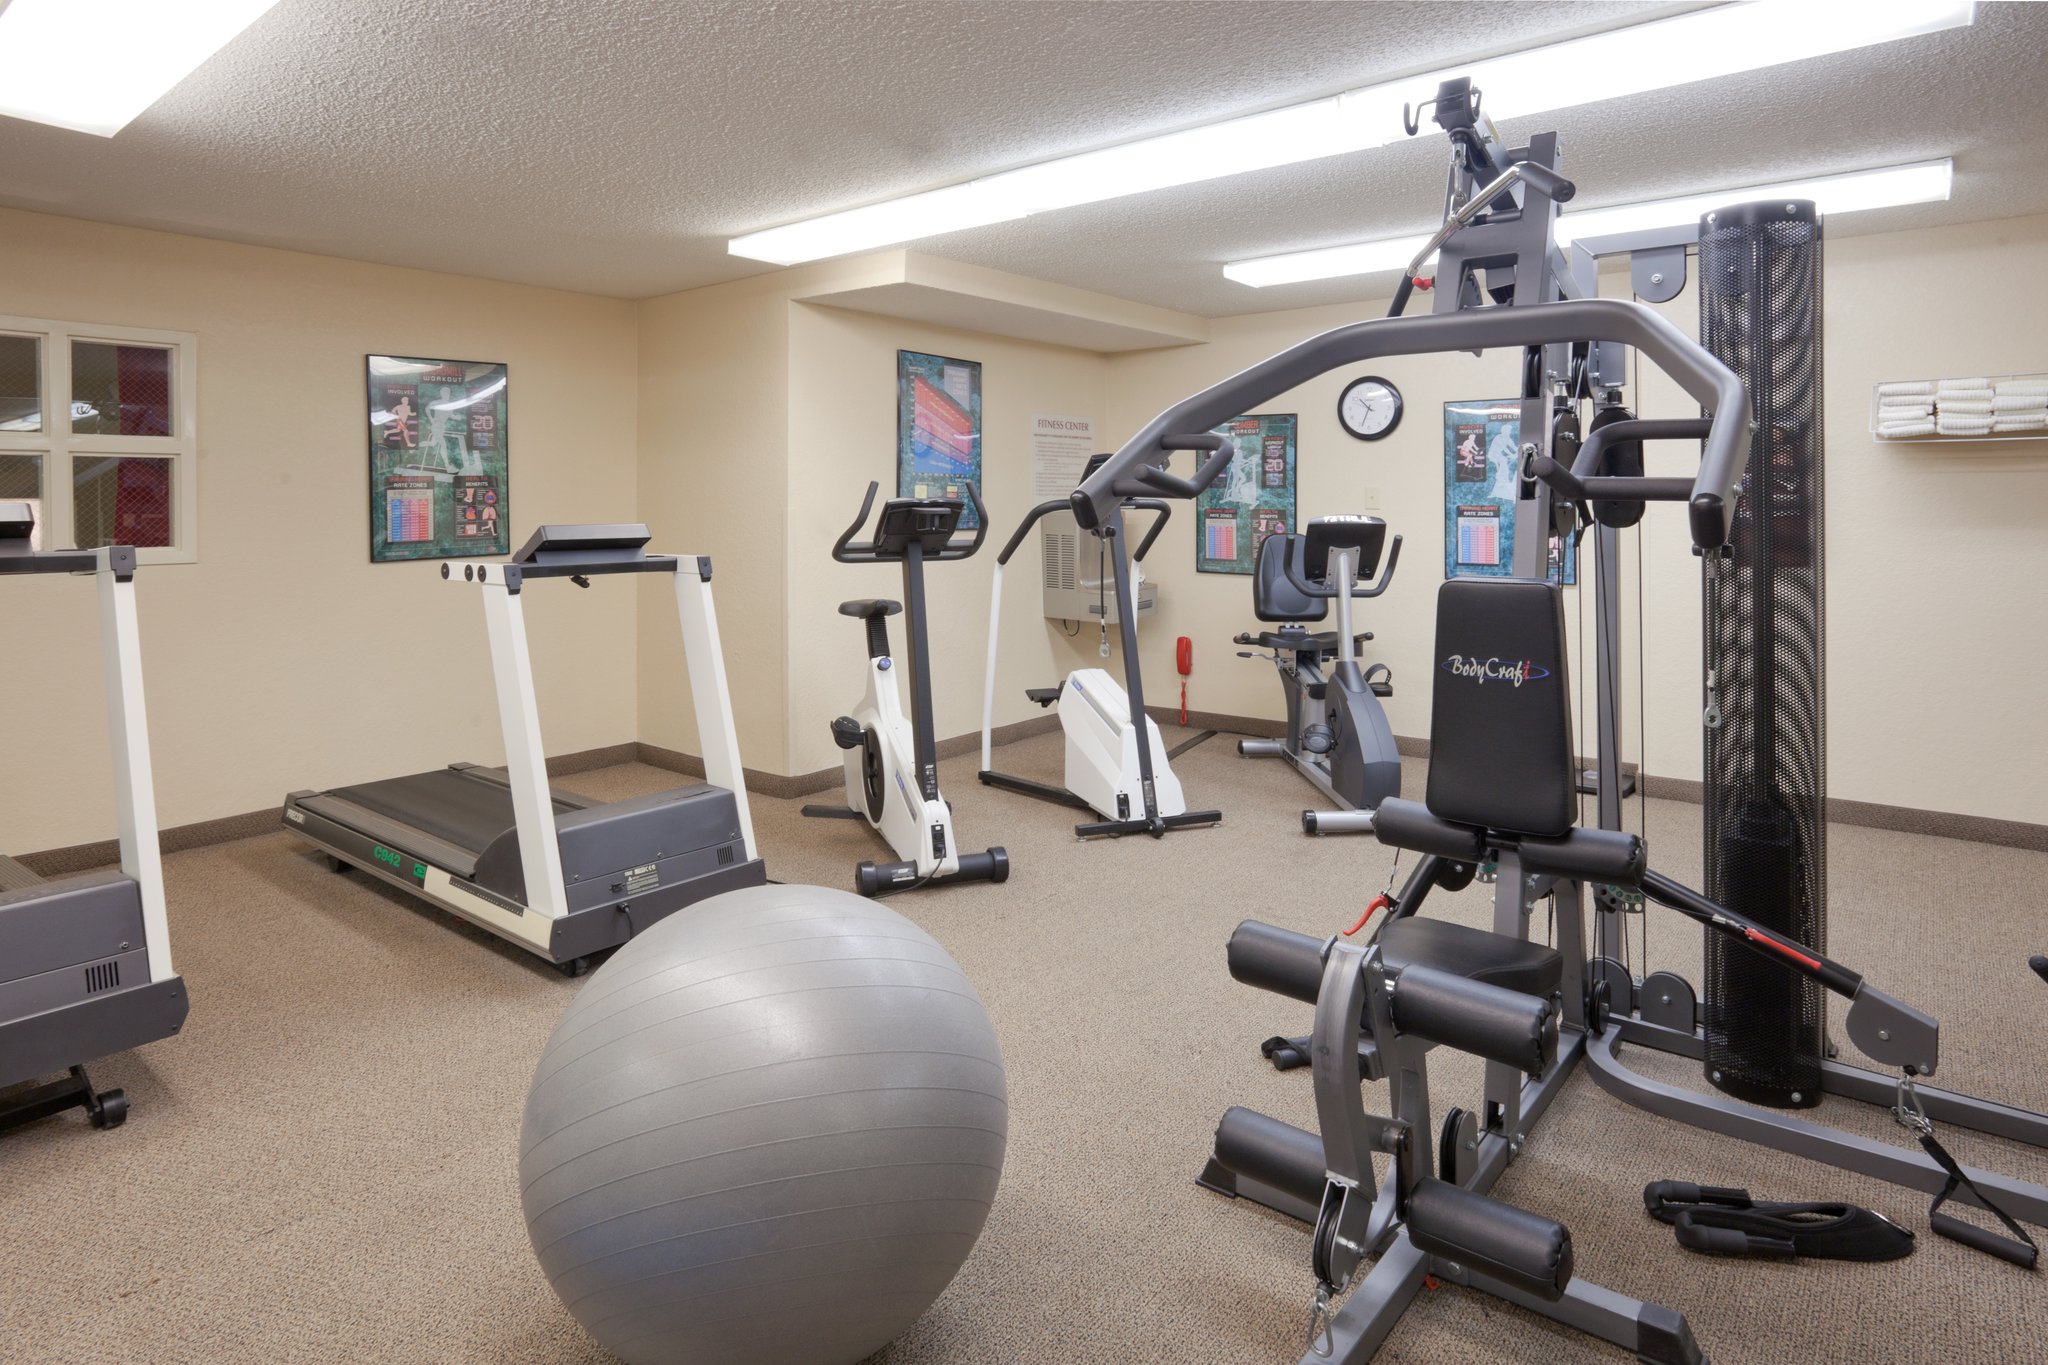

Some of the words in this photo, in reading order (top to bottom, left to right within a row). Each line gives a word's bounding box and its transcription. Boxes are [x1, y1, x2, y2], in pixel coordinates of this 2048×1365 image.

[423, 375, 463, 383] WORKOUT
[1037, 419, 1064, 430] FITNESS
[1065, 421, 1089, 431] CENTER
[1265, 458, 1283, 471] 20
[373, 845, 401, 868] C942
